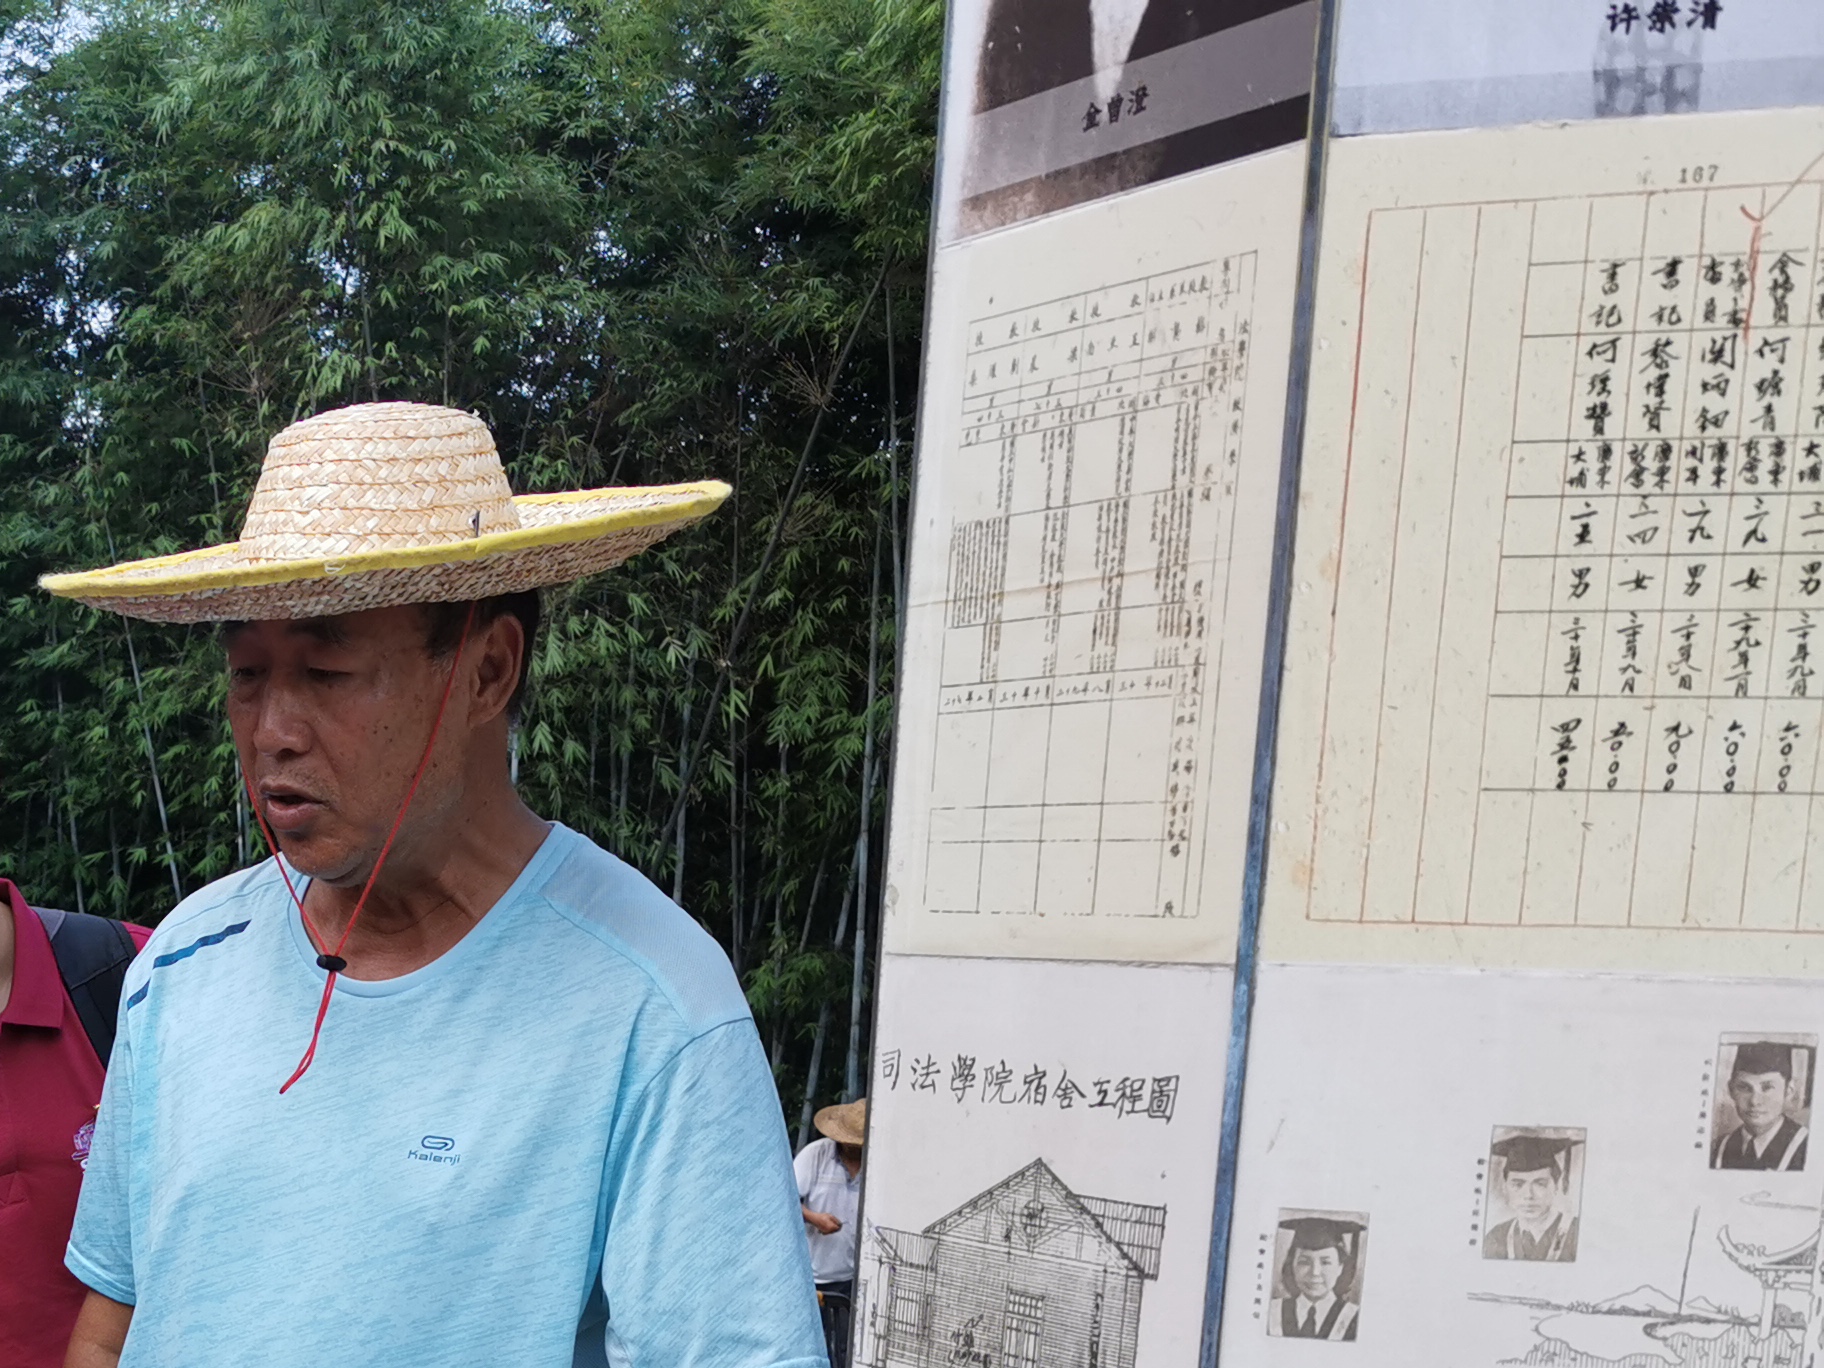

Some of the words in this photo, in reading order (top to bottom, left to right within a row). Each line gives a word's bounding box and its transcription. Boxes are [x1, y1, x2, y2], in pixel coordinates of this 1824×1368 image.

[1679, 164, 1719, 184] 167
[1568, 566, 1592, 600] 男
[1618, 570, 1654, 592] 女
[1684, 563, 1706, 596] 男
[1730, 567, 1767, 592] 女
[1799, 561, 1822, 596] 男
[407, 1149, 461, 1166] Kalenji
